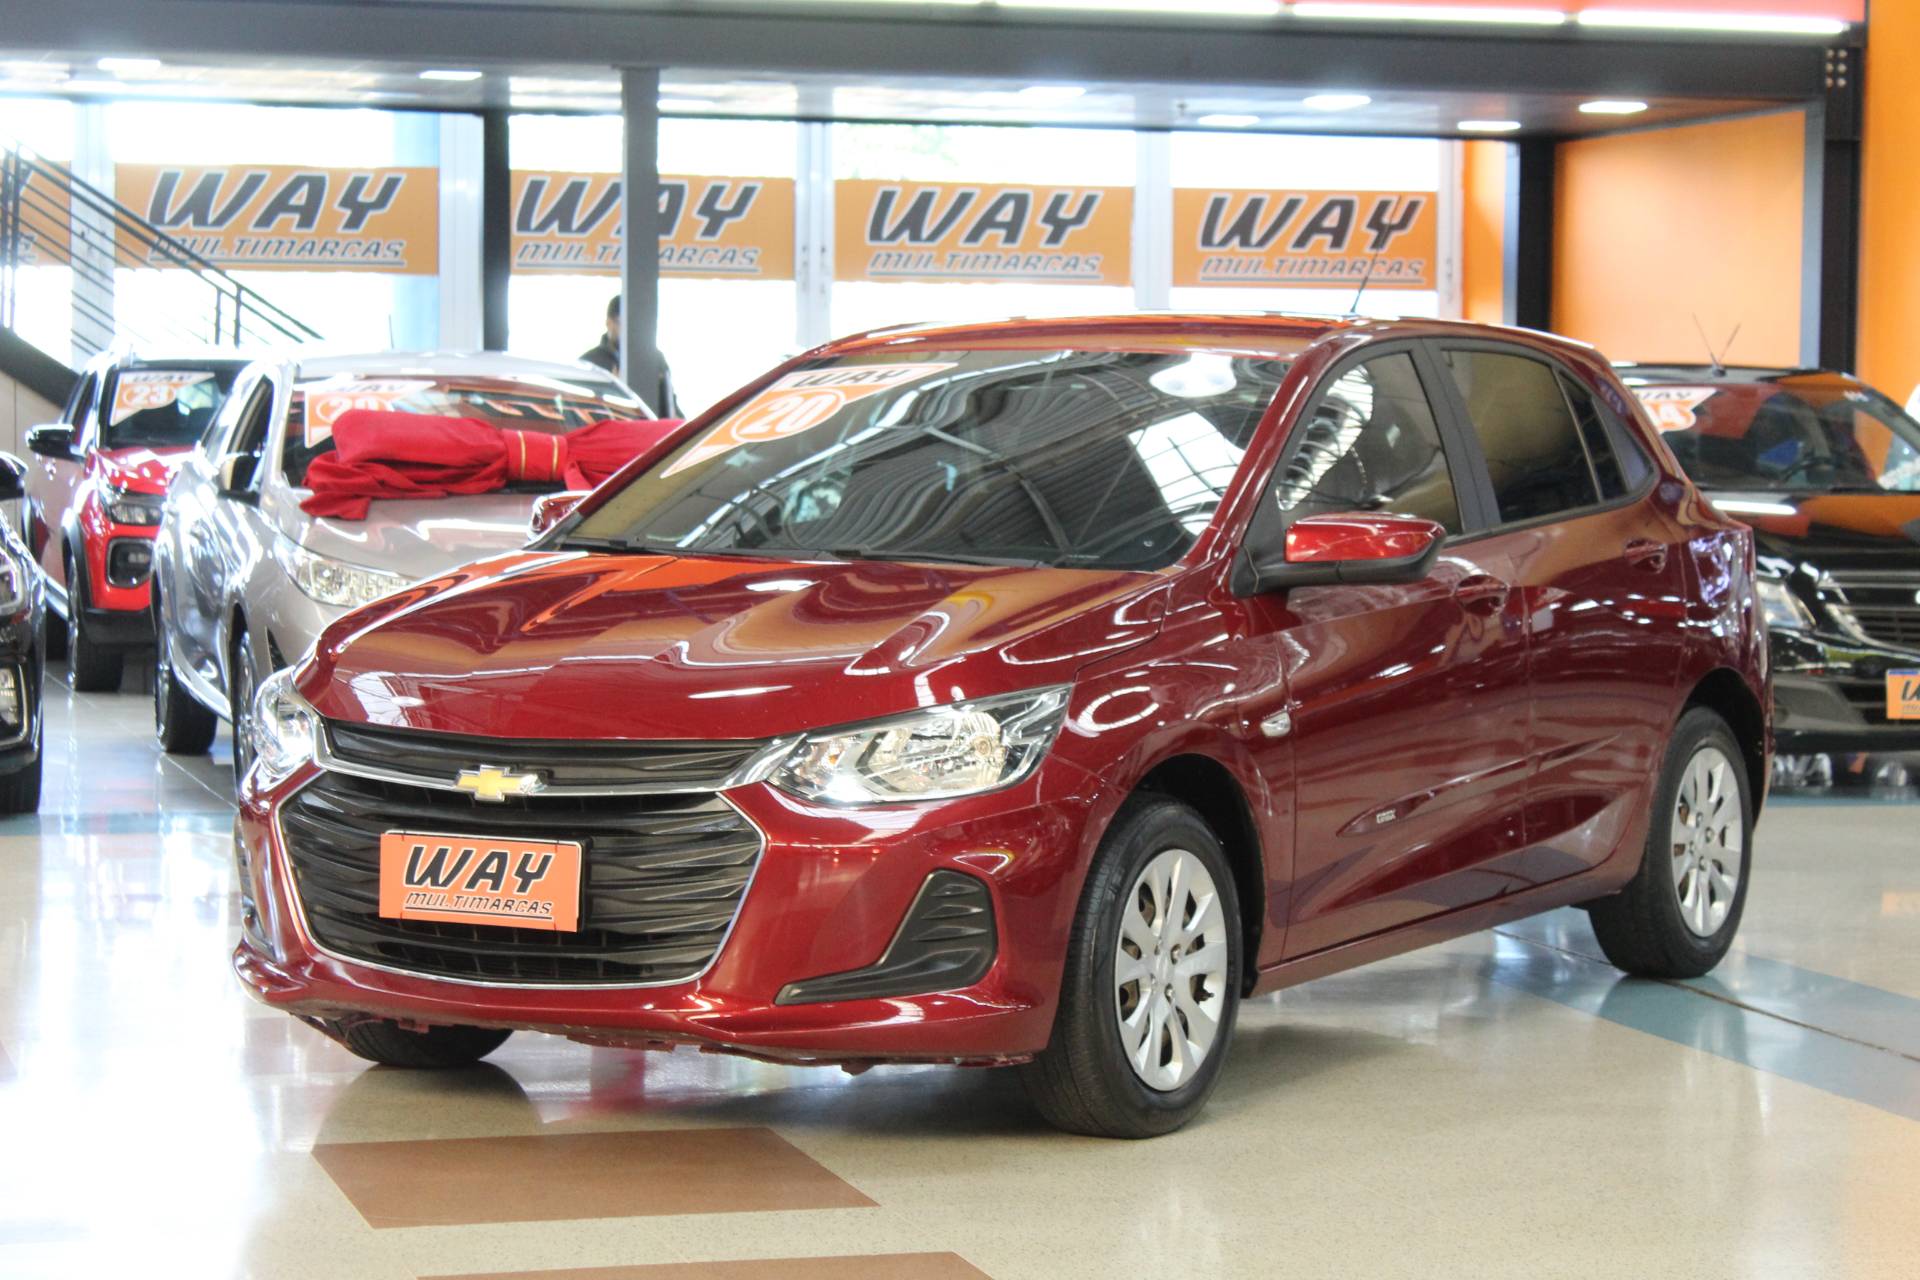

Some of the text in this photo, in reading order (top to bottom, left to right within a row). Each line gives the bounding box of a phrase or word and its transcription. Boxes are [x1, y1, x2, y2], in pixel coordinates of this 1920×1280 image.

[149, 171, 402, 231] WAY
[868, 189, 1100, 245] WAY
[1200, 196, 1422, 250] WAY
[151, 237, 404, 259] MULTIMARCAS
[517, 243, 760, 265] MULTIARCAS
[870, 253, 1101, 272] MULTIMARCAS
[1202, 258, 1424, 275] MULTIMARCAS
[793, 369, 912, 387] WAY
[738, 393, 838, 434] 20
[405, 846, 553, 894] WAY
[405, 892, 553, 915] MULTIMARCAS
